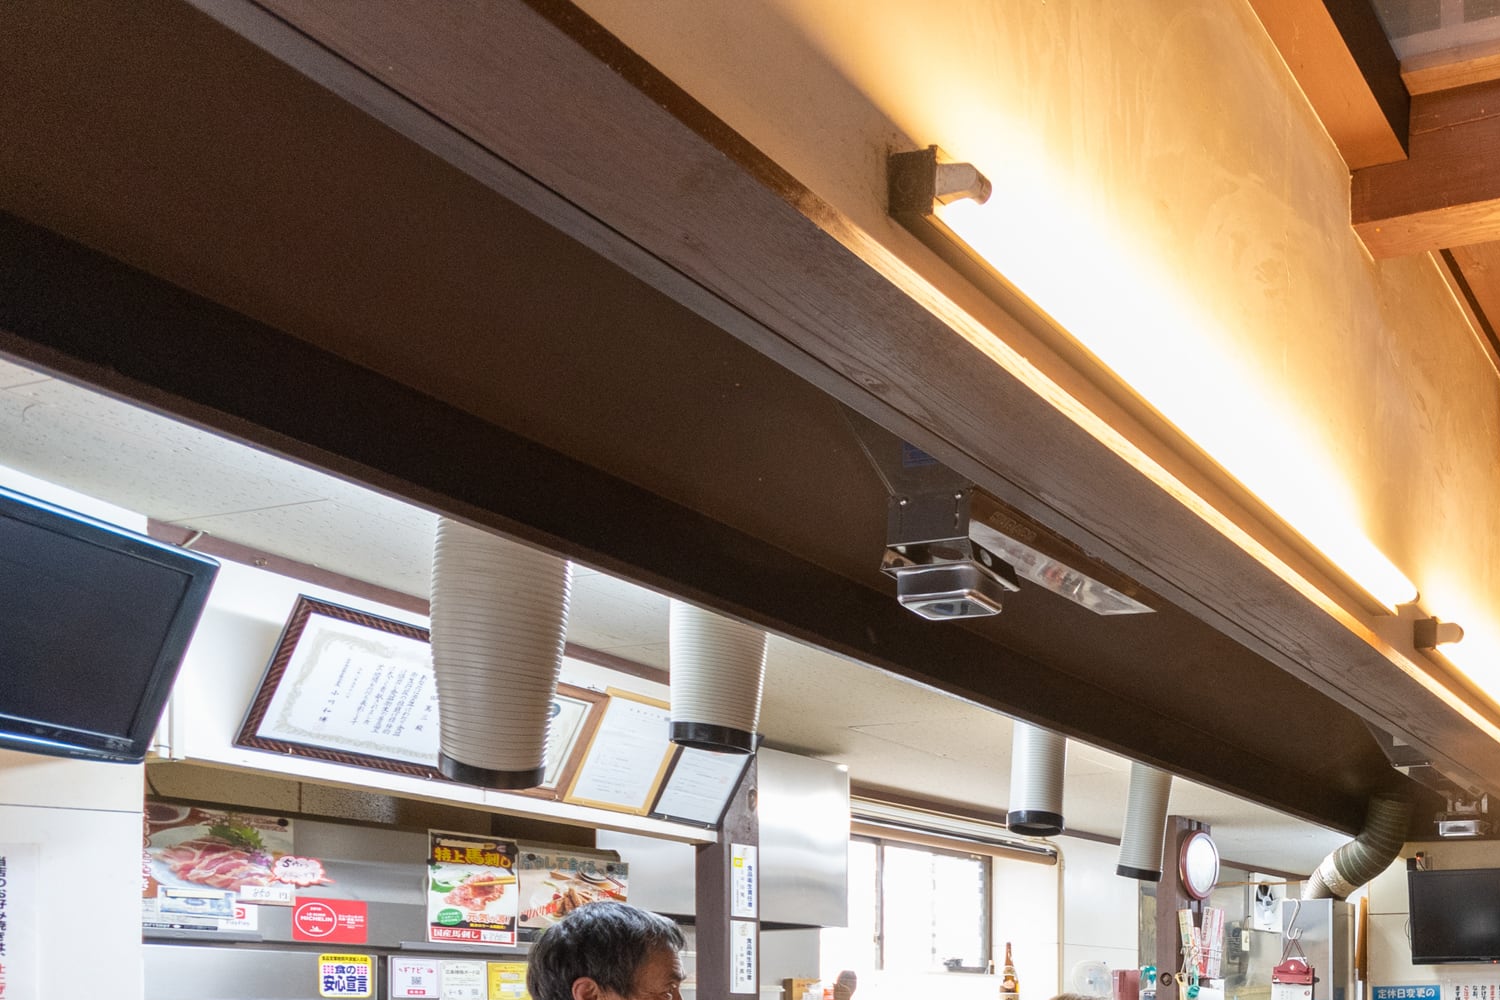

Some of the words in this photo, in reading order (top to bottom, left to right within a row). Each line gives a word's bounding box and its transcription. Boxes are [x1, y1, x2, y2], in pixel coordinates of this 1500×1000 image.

[434, 847, 512, 868] 特上馬刺し
[433, 929, 479, 940] 国産馬刺し
[335, 965, 356, 975] 食の
[323, 975, 368, 992] 安心宣言
[1377, 988, 1435, 999] 定休日変更の
